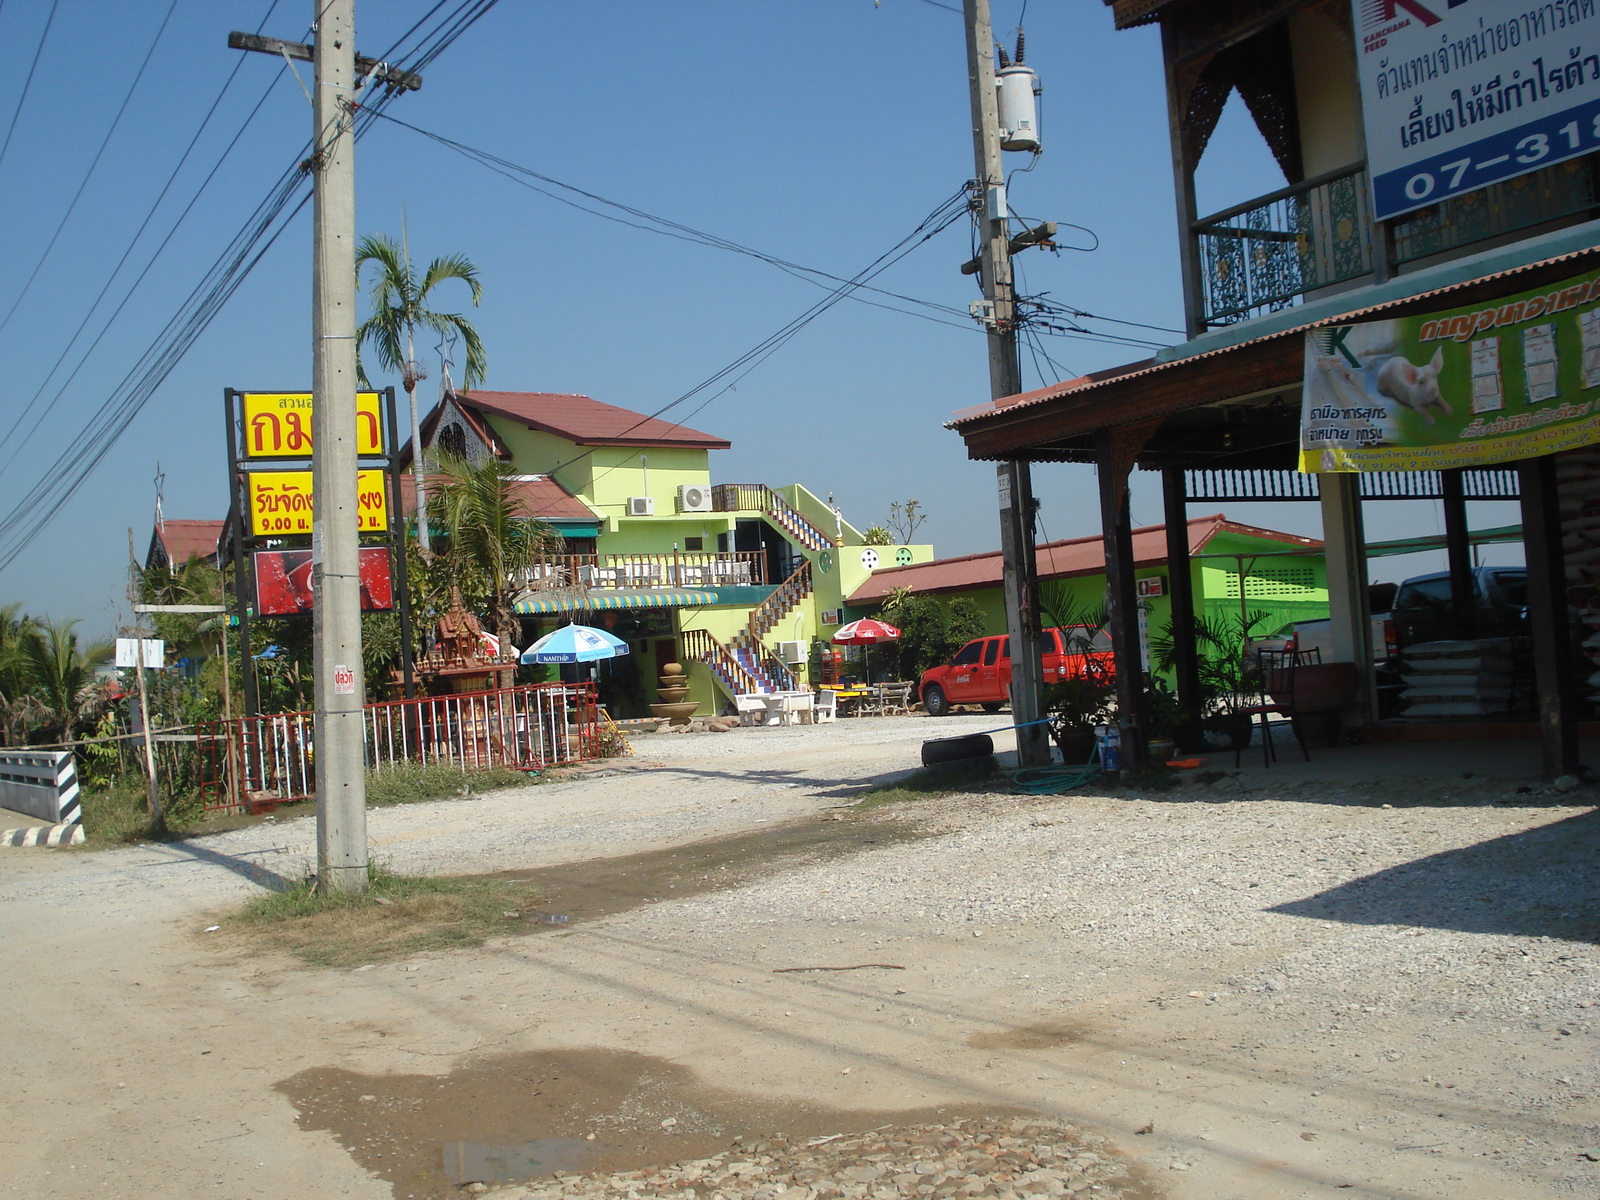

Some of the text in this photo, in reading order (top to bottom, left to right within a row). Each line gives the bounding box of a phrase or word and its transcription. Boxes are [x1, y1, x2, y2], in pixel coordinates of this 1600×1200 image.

[1363, 18, 1411, 44] KANCHANA
[1364, 38, 1388, 54] FEED
[1405, 113, 1600, 200] 07-31
[543, 654, 570, 663] NAMTHIP
